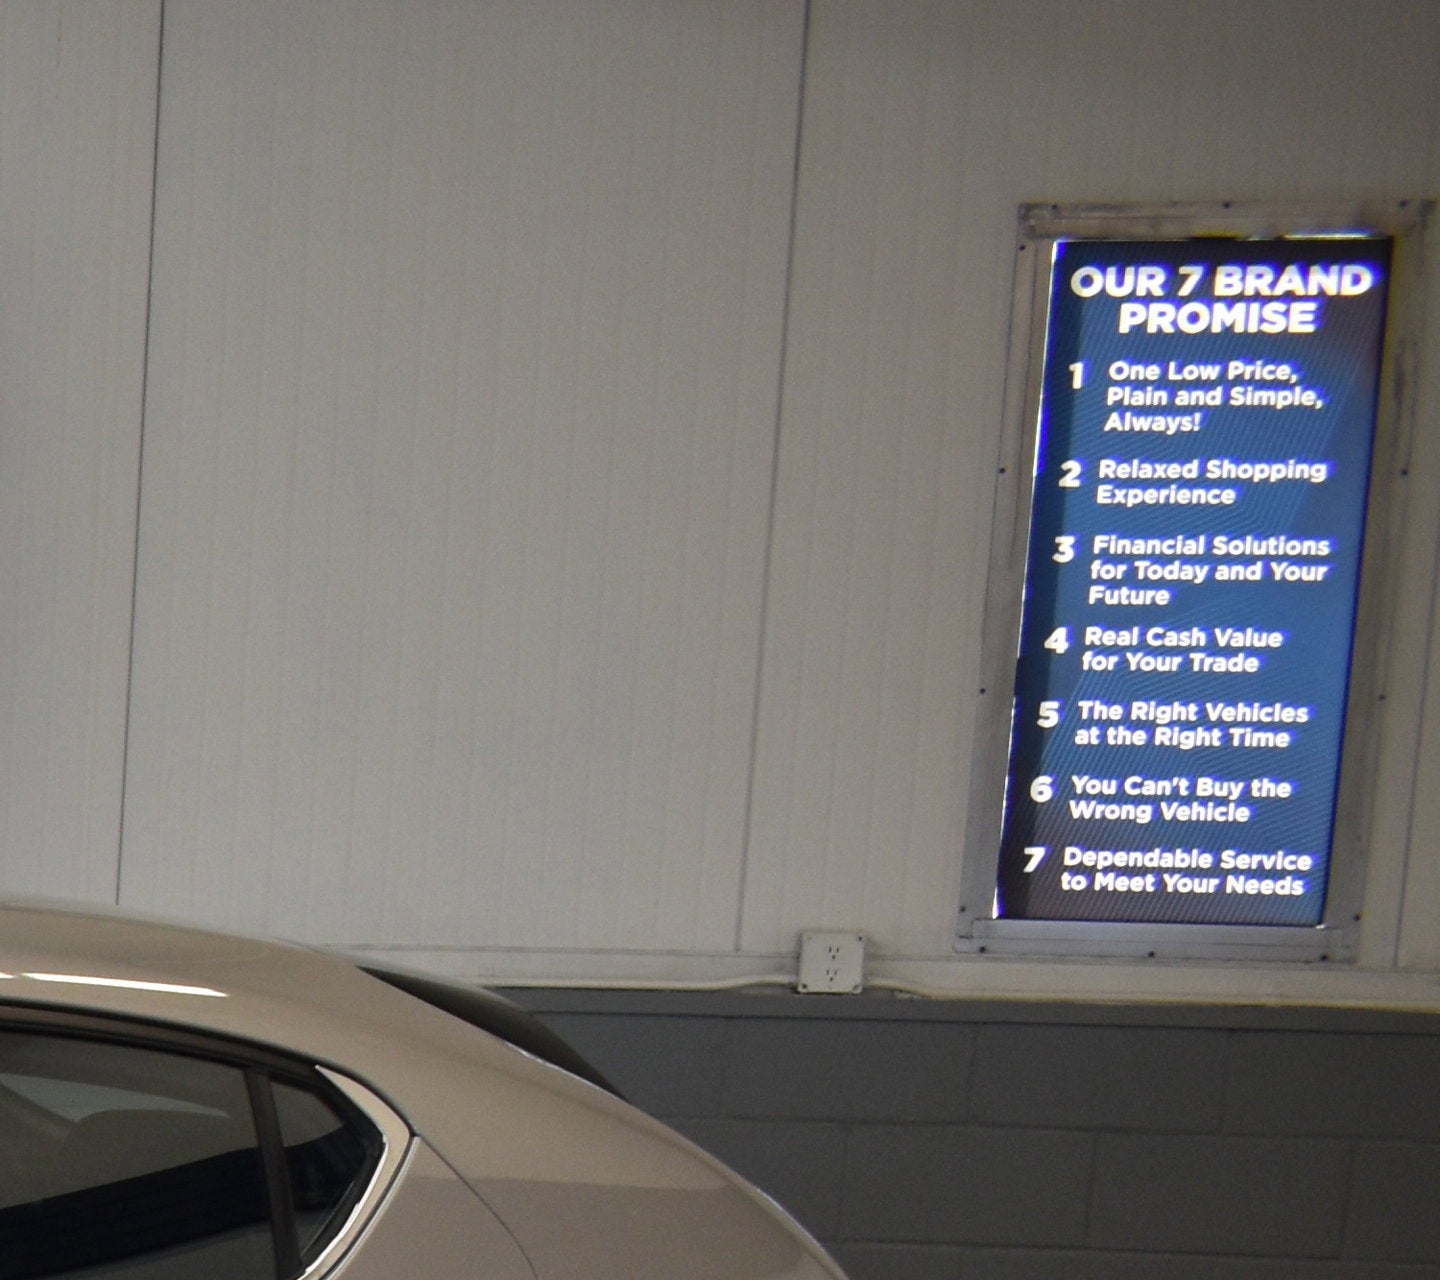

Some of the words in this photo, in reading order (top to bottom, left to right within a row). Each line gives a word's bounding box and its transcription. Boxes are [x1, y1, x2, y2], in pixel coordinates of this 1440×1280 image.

[1072, 267, 1165, 297] OUR
[1178, 267, 1202, 296] 7
[1215, 266, 1371, 295] BRAND
[1119, 302, 1316, 333] PROMISE
[1070, 362, 1083, 389] 1
[1109, 362, 1160, 380] One
[1168, 362, 1219, 380] Low
[1228, 361, 1296, 383] Price,
[1107, 387, 1167, 405] Plain
[1175, 387, 1222, 405] and
[1230, 386, 1322, 409] Simple,
[1104, 412, 1200, 434] Always!
[1059, 461, 1081, 487] 2
[1099, 459, 1198, 478] Relaxed
[1206, 460, 1326, 482] Shopping
[1097, 485, 1235, 507] Experience
[1053, 536, 1075, 562] 3
[1094, 535, 1204, 554] Financial
[1213, 536, 1329, 555] Solutions
[1091, 561, 1127, 579] for
[1134, 561, 1208, 583] Today
[1215, 562, 1262, 580] and
[1271, 562, 1327, 581] Your
[1089, 586, 1169, 605] Future
[1045, 627, 1069, 653] 4
[1085, 627, 1138, 645] Real
[1146, 627, 1206, 646] Cash
[1215, 628, 1282, 647] Value
[1083, 652, 1118, 670] for
[1126, 653, 1182, 671] Your
[1190, 653, 1259, 672] Trade
[1038, 701, 1059, 727] 5
[1078, 701, 1123, 720] The
[1131, 701, 1197, 724] Right
[1206, 703, 1308, 722] Vehicles
[1075, 728, 1099, 744] at
[1107, 727, 1146, 745] the
[1155, 727, 1221, 749] Right
[1229, 728, 1290, 747] Time
[1031, 776, 1052, 802] 6
[1072, 776, 1116, 794] You
[1125, 776, 1189, 796] Can't
[1196, 778, 1244, 800] Buy
[1251, 778, 1291, 797] the
[1070, 801, 1152, 823] Wrong
[1161, 802, 1250, 822] Vehicle
[1024, 847, 1045, 872] 7
[1064, 847, 1213, 869] Dependable
[1220, 850, 1312, 870] Service
[1062, 873, 1087, 890] to
[1095, 873, 1155, 892] Meet
[1163, 874, 1219, 893] Your
[1226, 875, 1303, 895] Needs
